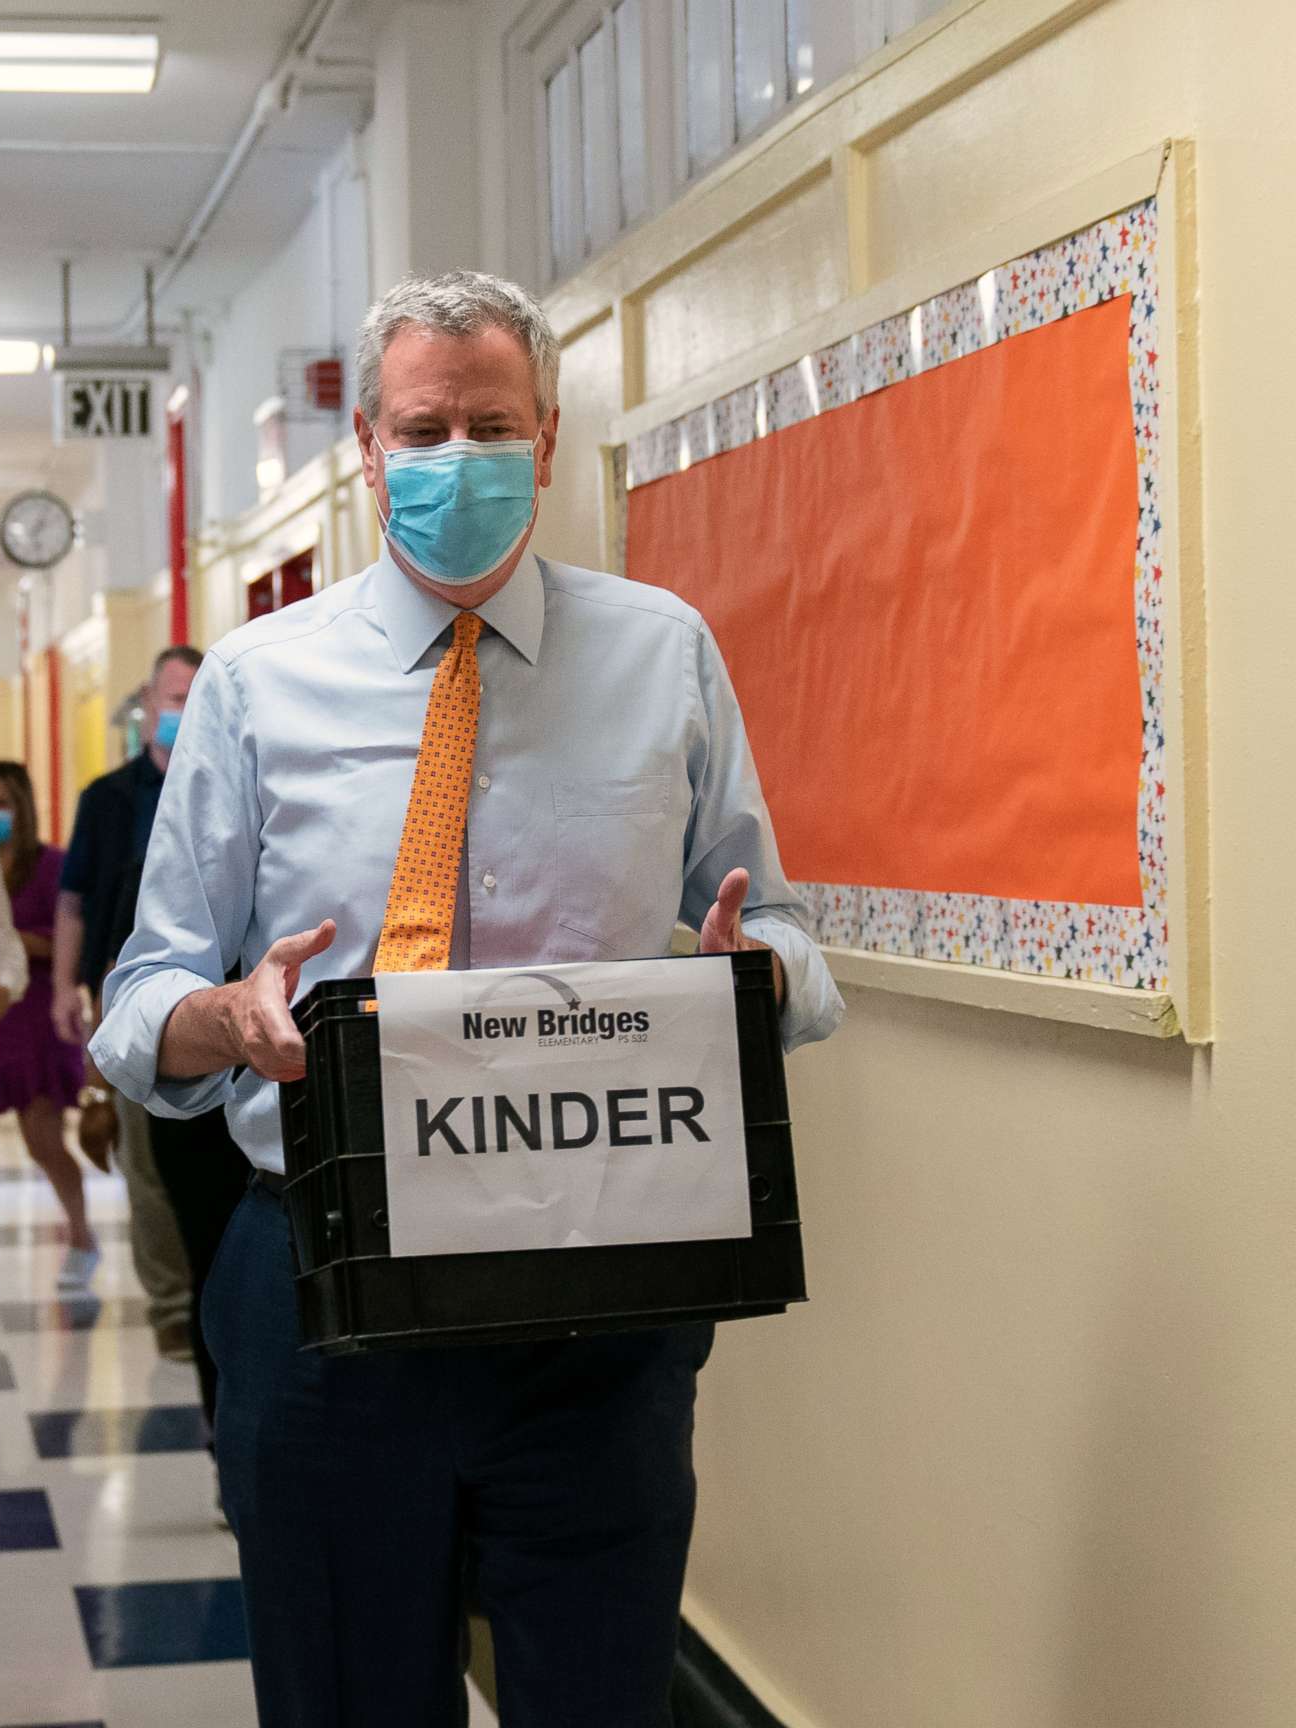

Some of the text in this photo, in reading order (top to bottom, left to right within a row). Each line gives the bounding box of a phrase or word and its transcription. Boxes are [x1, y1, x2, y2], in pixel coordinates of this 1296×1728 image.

[64, 381, 151, 436] EXIT
[462, 1007, 650, 1040] New Bridges
[537, 1036, 599, 1047] ELEMENTARY
[618, 1035, 629, 1043] PS
[415, 1086, 712, 1157] KINDER
